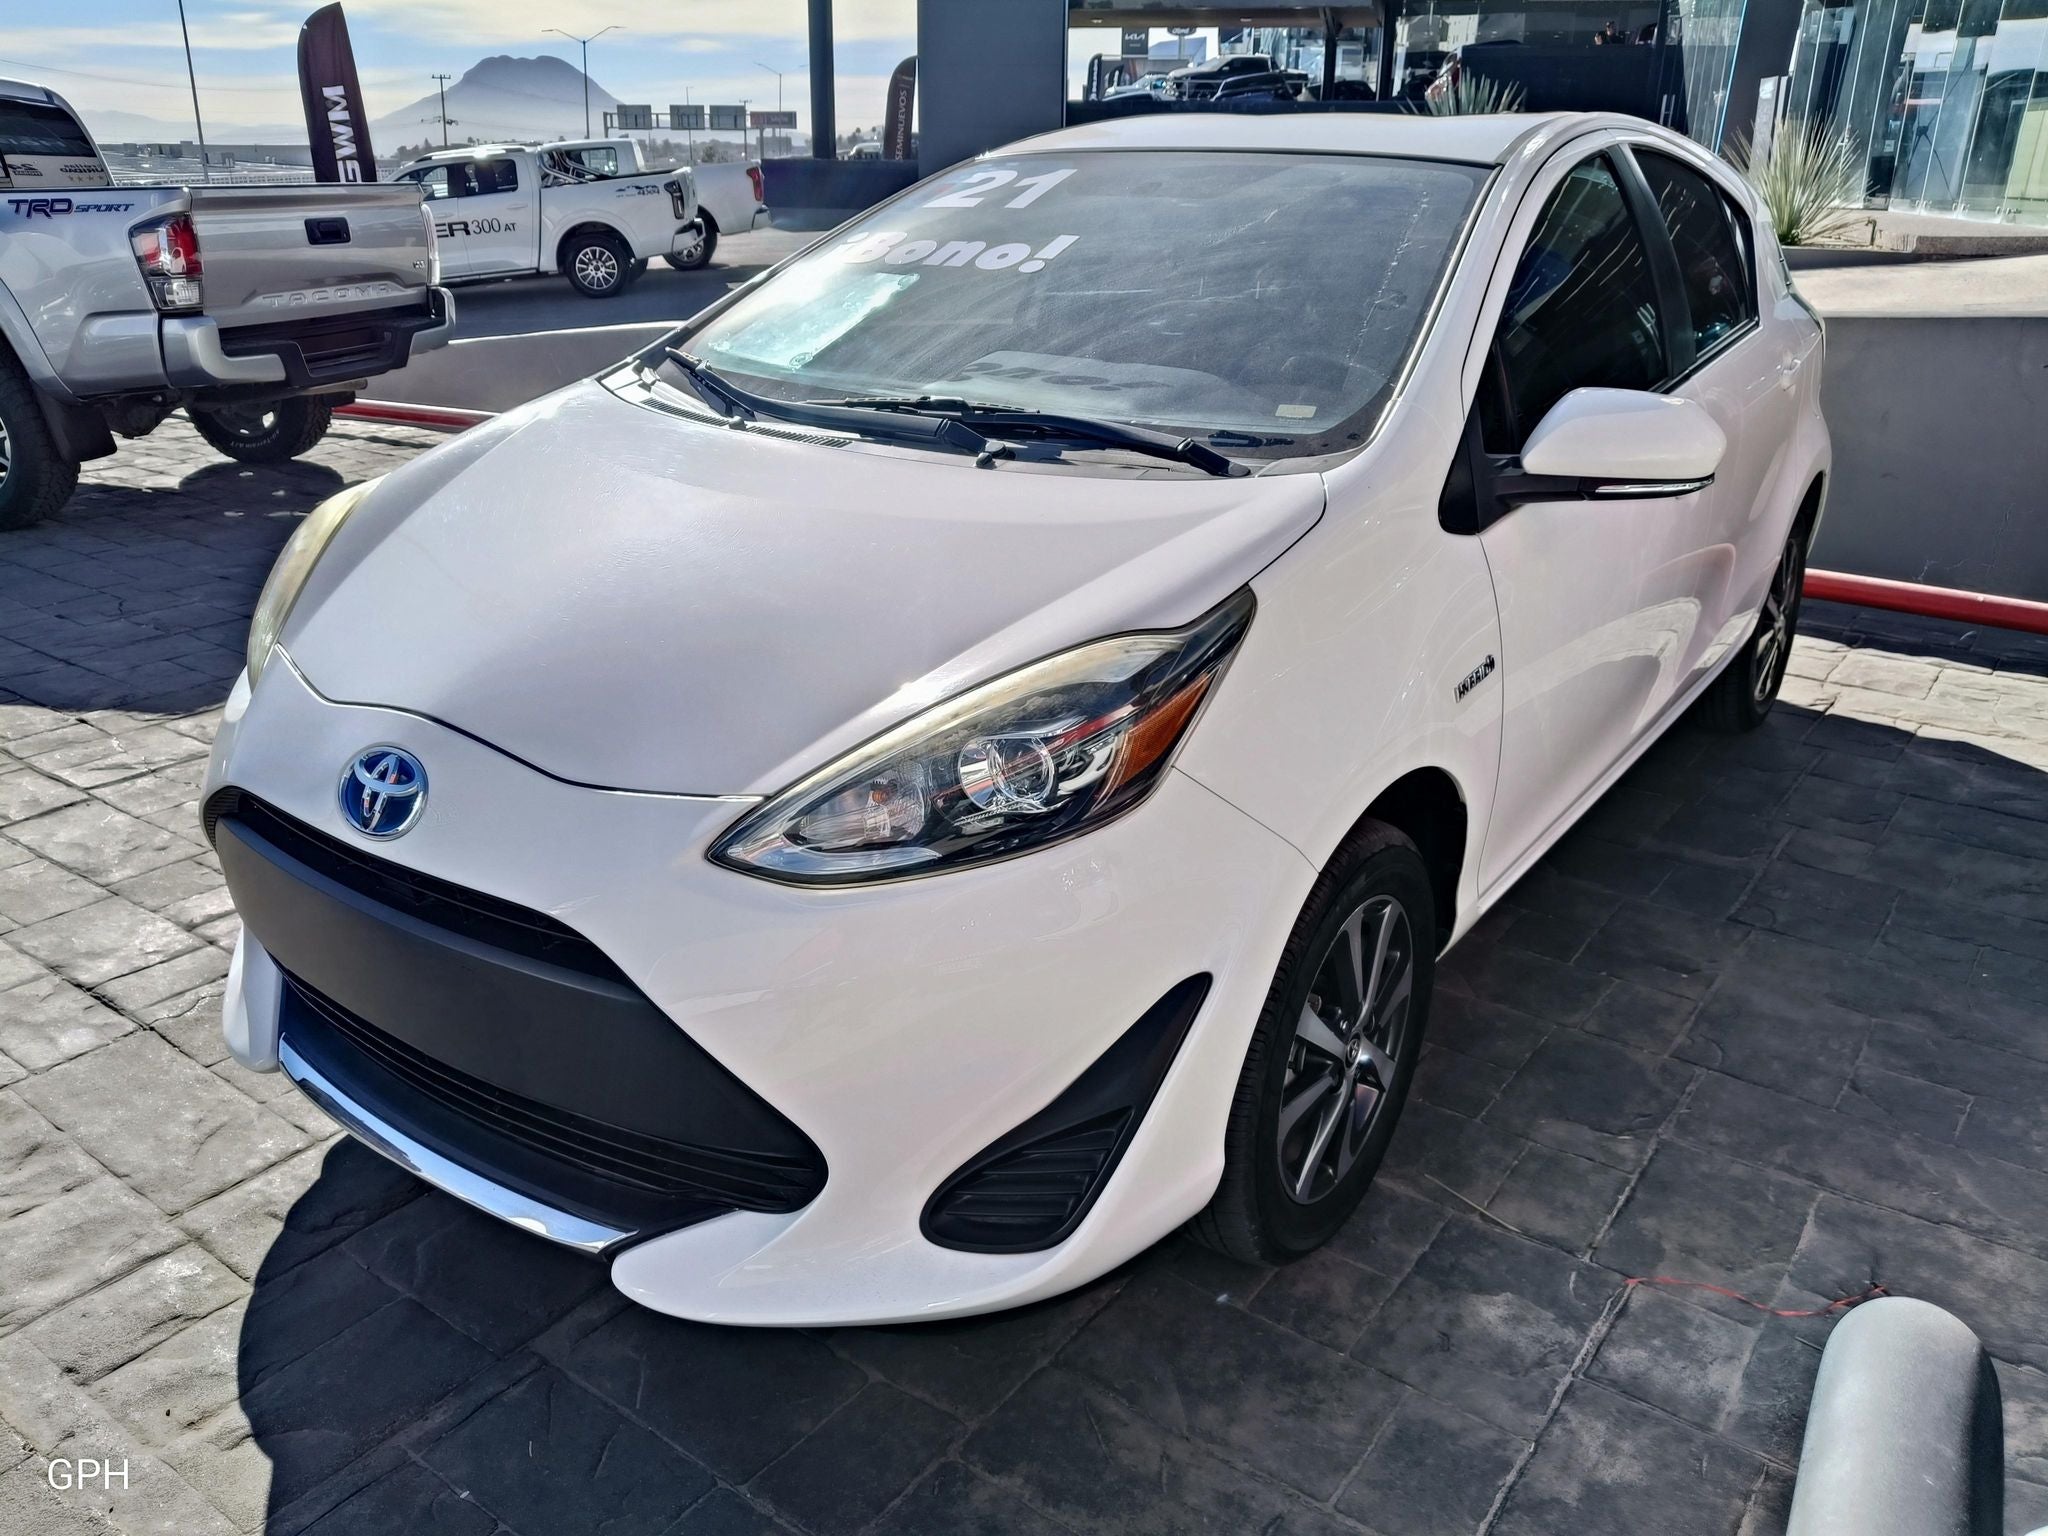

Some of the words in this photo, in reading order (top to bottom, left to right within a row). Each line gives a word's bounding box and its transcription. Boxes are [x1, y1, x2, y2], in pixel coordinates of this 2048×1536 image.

[895, 89, 908, 160] SEMINUEVOS
[923, 168, 1078, 209] 21
[7, 198, 73, 219] TRD
[74, 203, 135, 213] SPORT
[504, 223, 516, 232] AT
[263, 283, 392, 307] TACOMA
